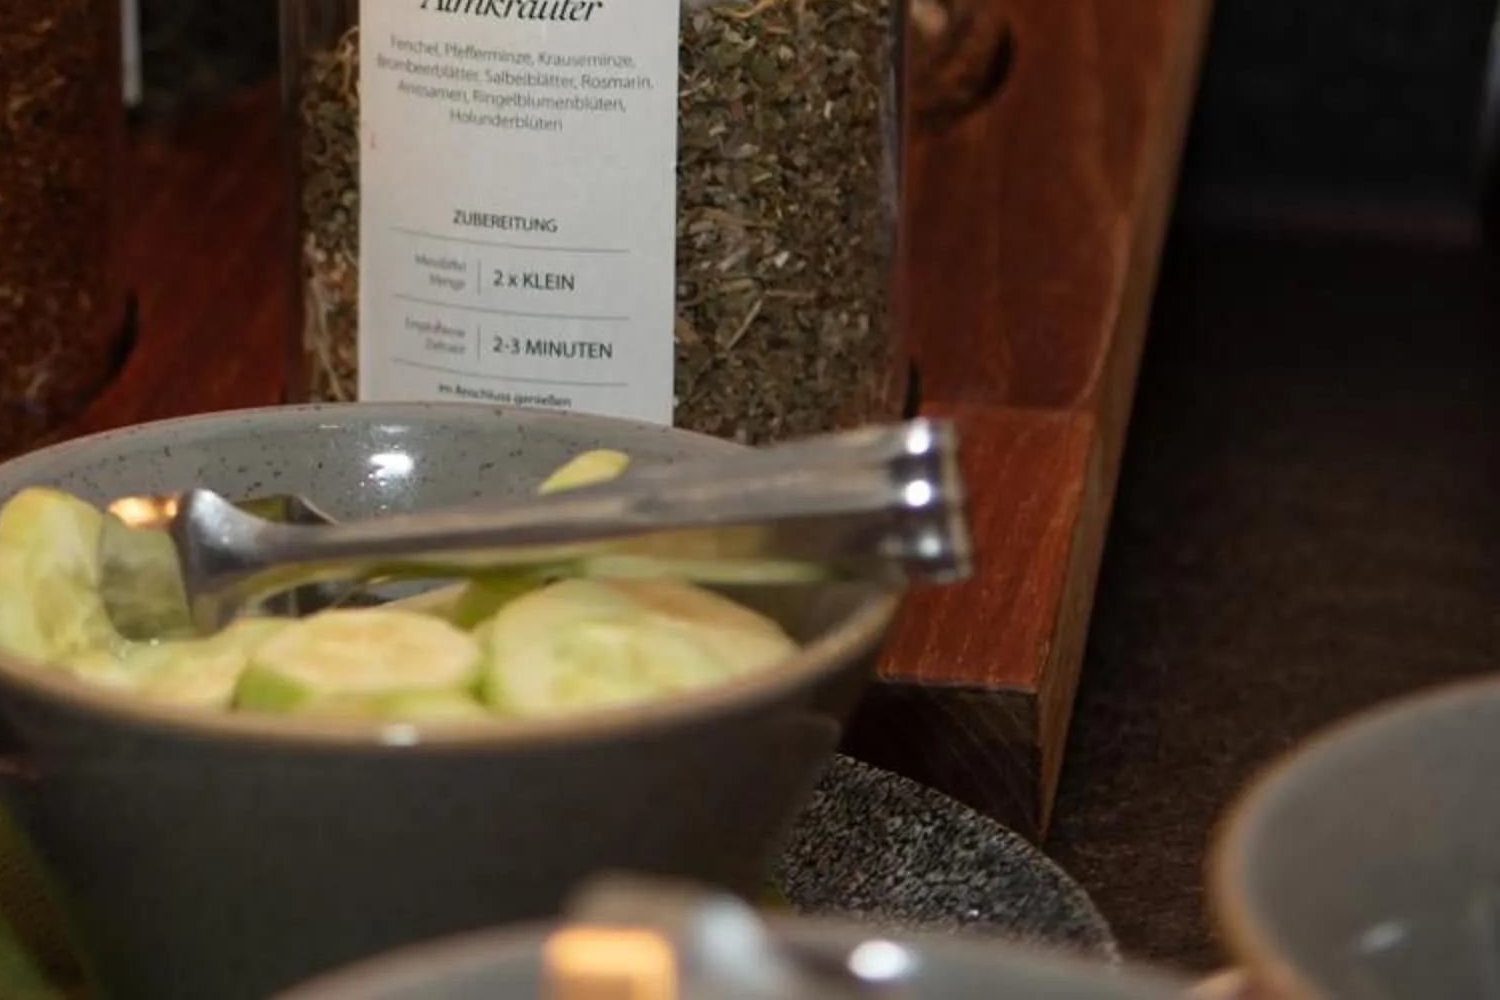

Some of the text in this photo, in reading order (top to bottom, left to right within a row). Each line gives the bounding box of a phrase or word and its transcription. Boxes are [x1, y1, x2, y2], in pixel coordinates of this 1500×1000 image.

[452, 209, 558, 233] ZUBEREITUNG
[493, 269, 575, 291] 2 x KLEIN
[492, 336, 613, 359] 2-3 MINUTEN
